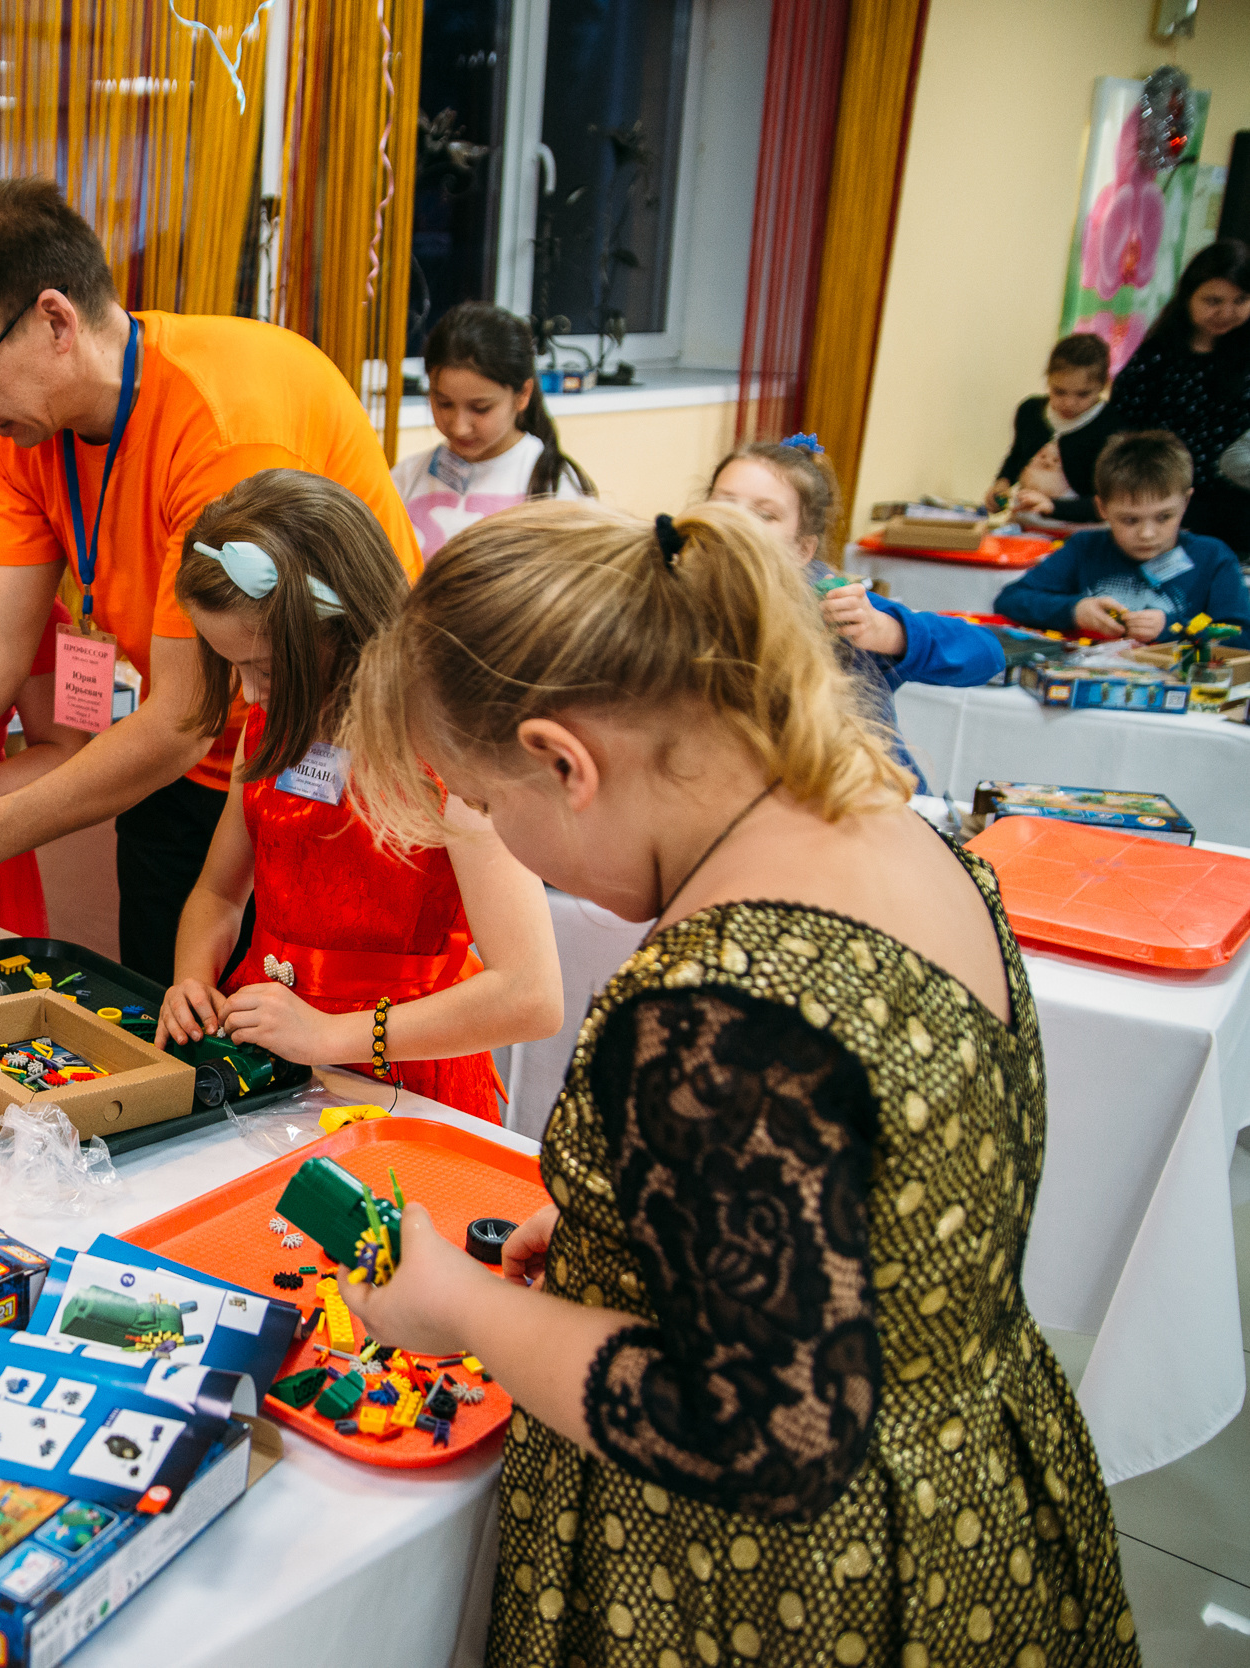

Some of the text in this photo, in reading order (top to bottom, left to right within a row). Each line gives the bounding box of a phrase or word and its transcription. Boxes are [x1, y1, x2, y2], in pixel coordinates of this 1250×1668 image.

[63, 643, 109, 659] ПРОФЕССОР
[72, 670, 97, 684] Юрий
[65, 682, 103, 698] Юрьевич
